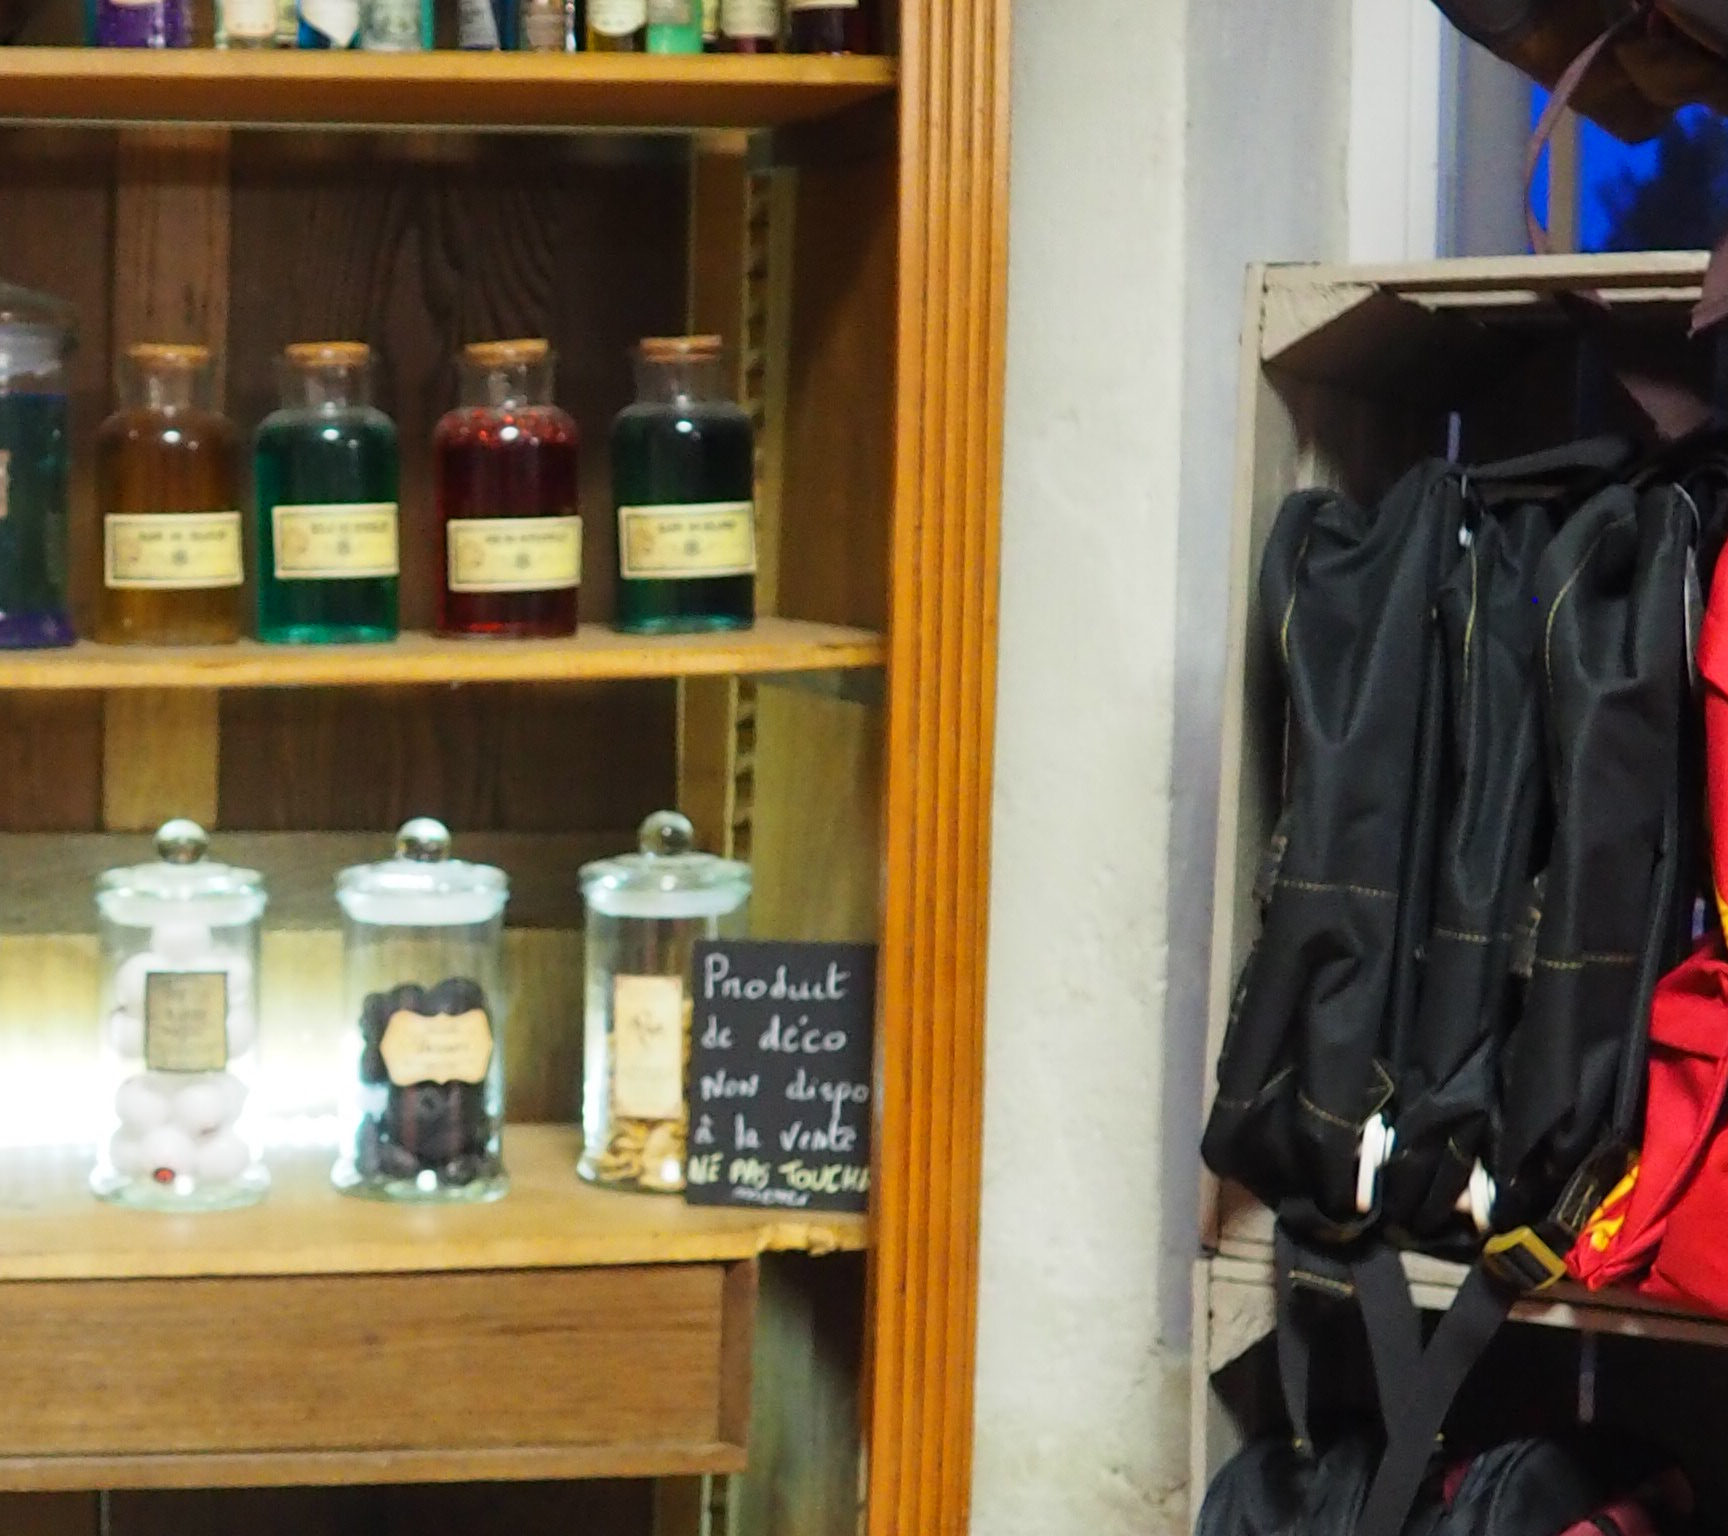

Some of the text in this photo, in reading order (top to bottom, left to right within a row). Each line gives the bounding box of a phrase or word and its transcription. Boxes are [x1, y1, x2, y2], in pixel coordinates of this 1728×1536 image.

[704, 952, 851, 1000] Produit
[701, 1014, 848, 1053] de déco
[785, 1066, 870, 1118] dispo
[734, 1113, 761, 1151] la
